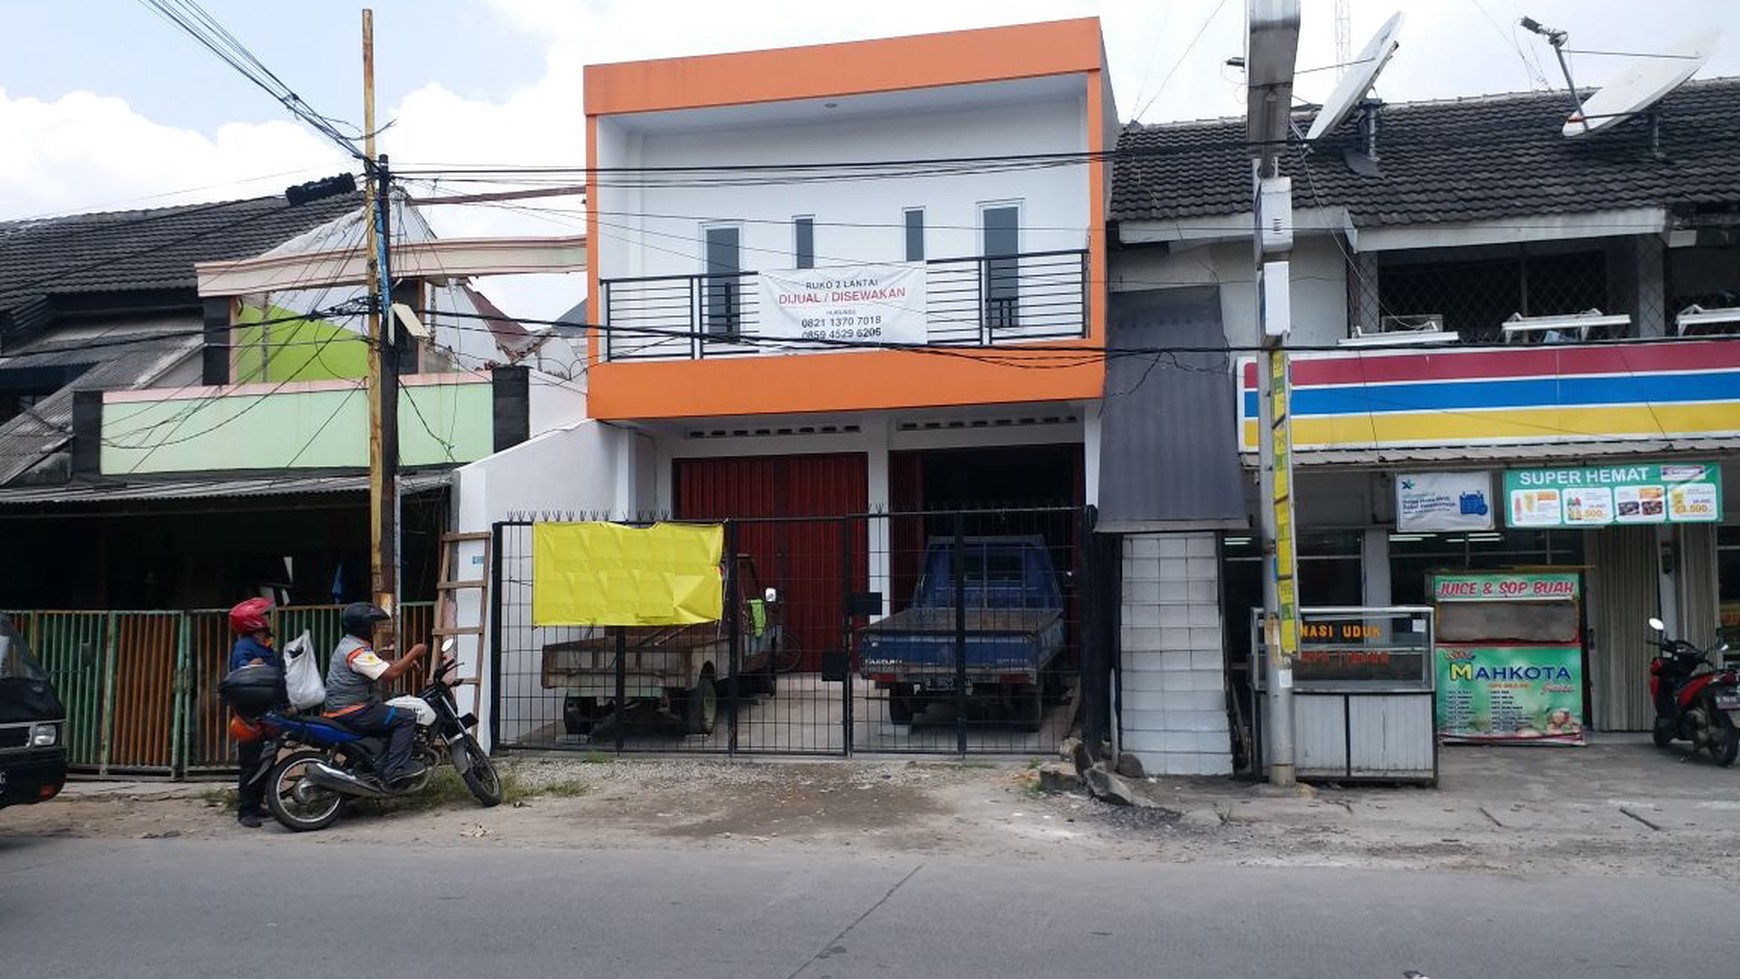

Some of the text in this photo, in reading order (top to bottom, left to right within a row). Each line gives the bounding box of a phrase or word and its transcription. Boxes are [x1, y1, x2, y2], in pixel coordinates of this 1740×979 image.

[806, 278, 879, 290] RUKO 2 LANTAI
[778, 286, 906, 305] DIJUAL / DISEWAKAN
[801, 315, 882, 328] 0821 1370 7018
[829, 329, 854, 339] 4529
[1520, 470, 1581, 485] SUPER
[1586, 467, 1649, 484] HEMAT
[1437, 581, 1575, 597] JUICE & SOP BUAH
[1299, 624, 1381, 639] NASI UDUK
[1450, 662, 1572, 681] MAHKOTA
